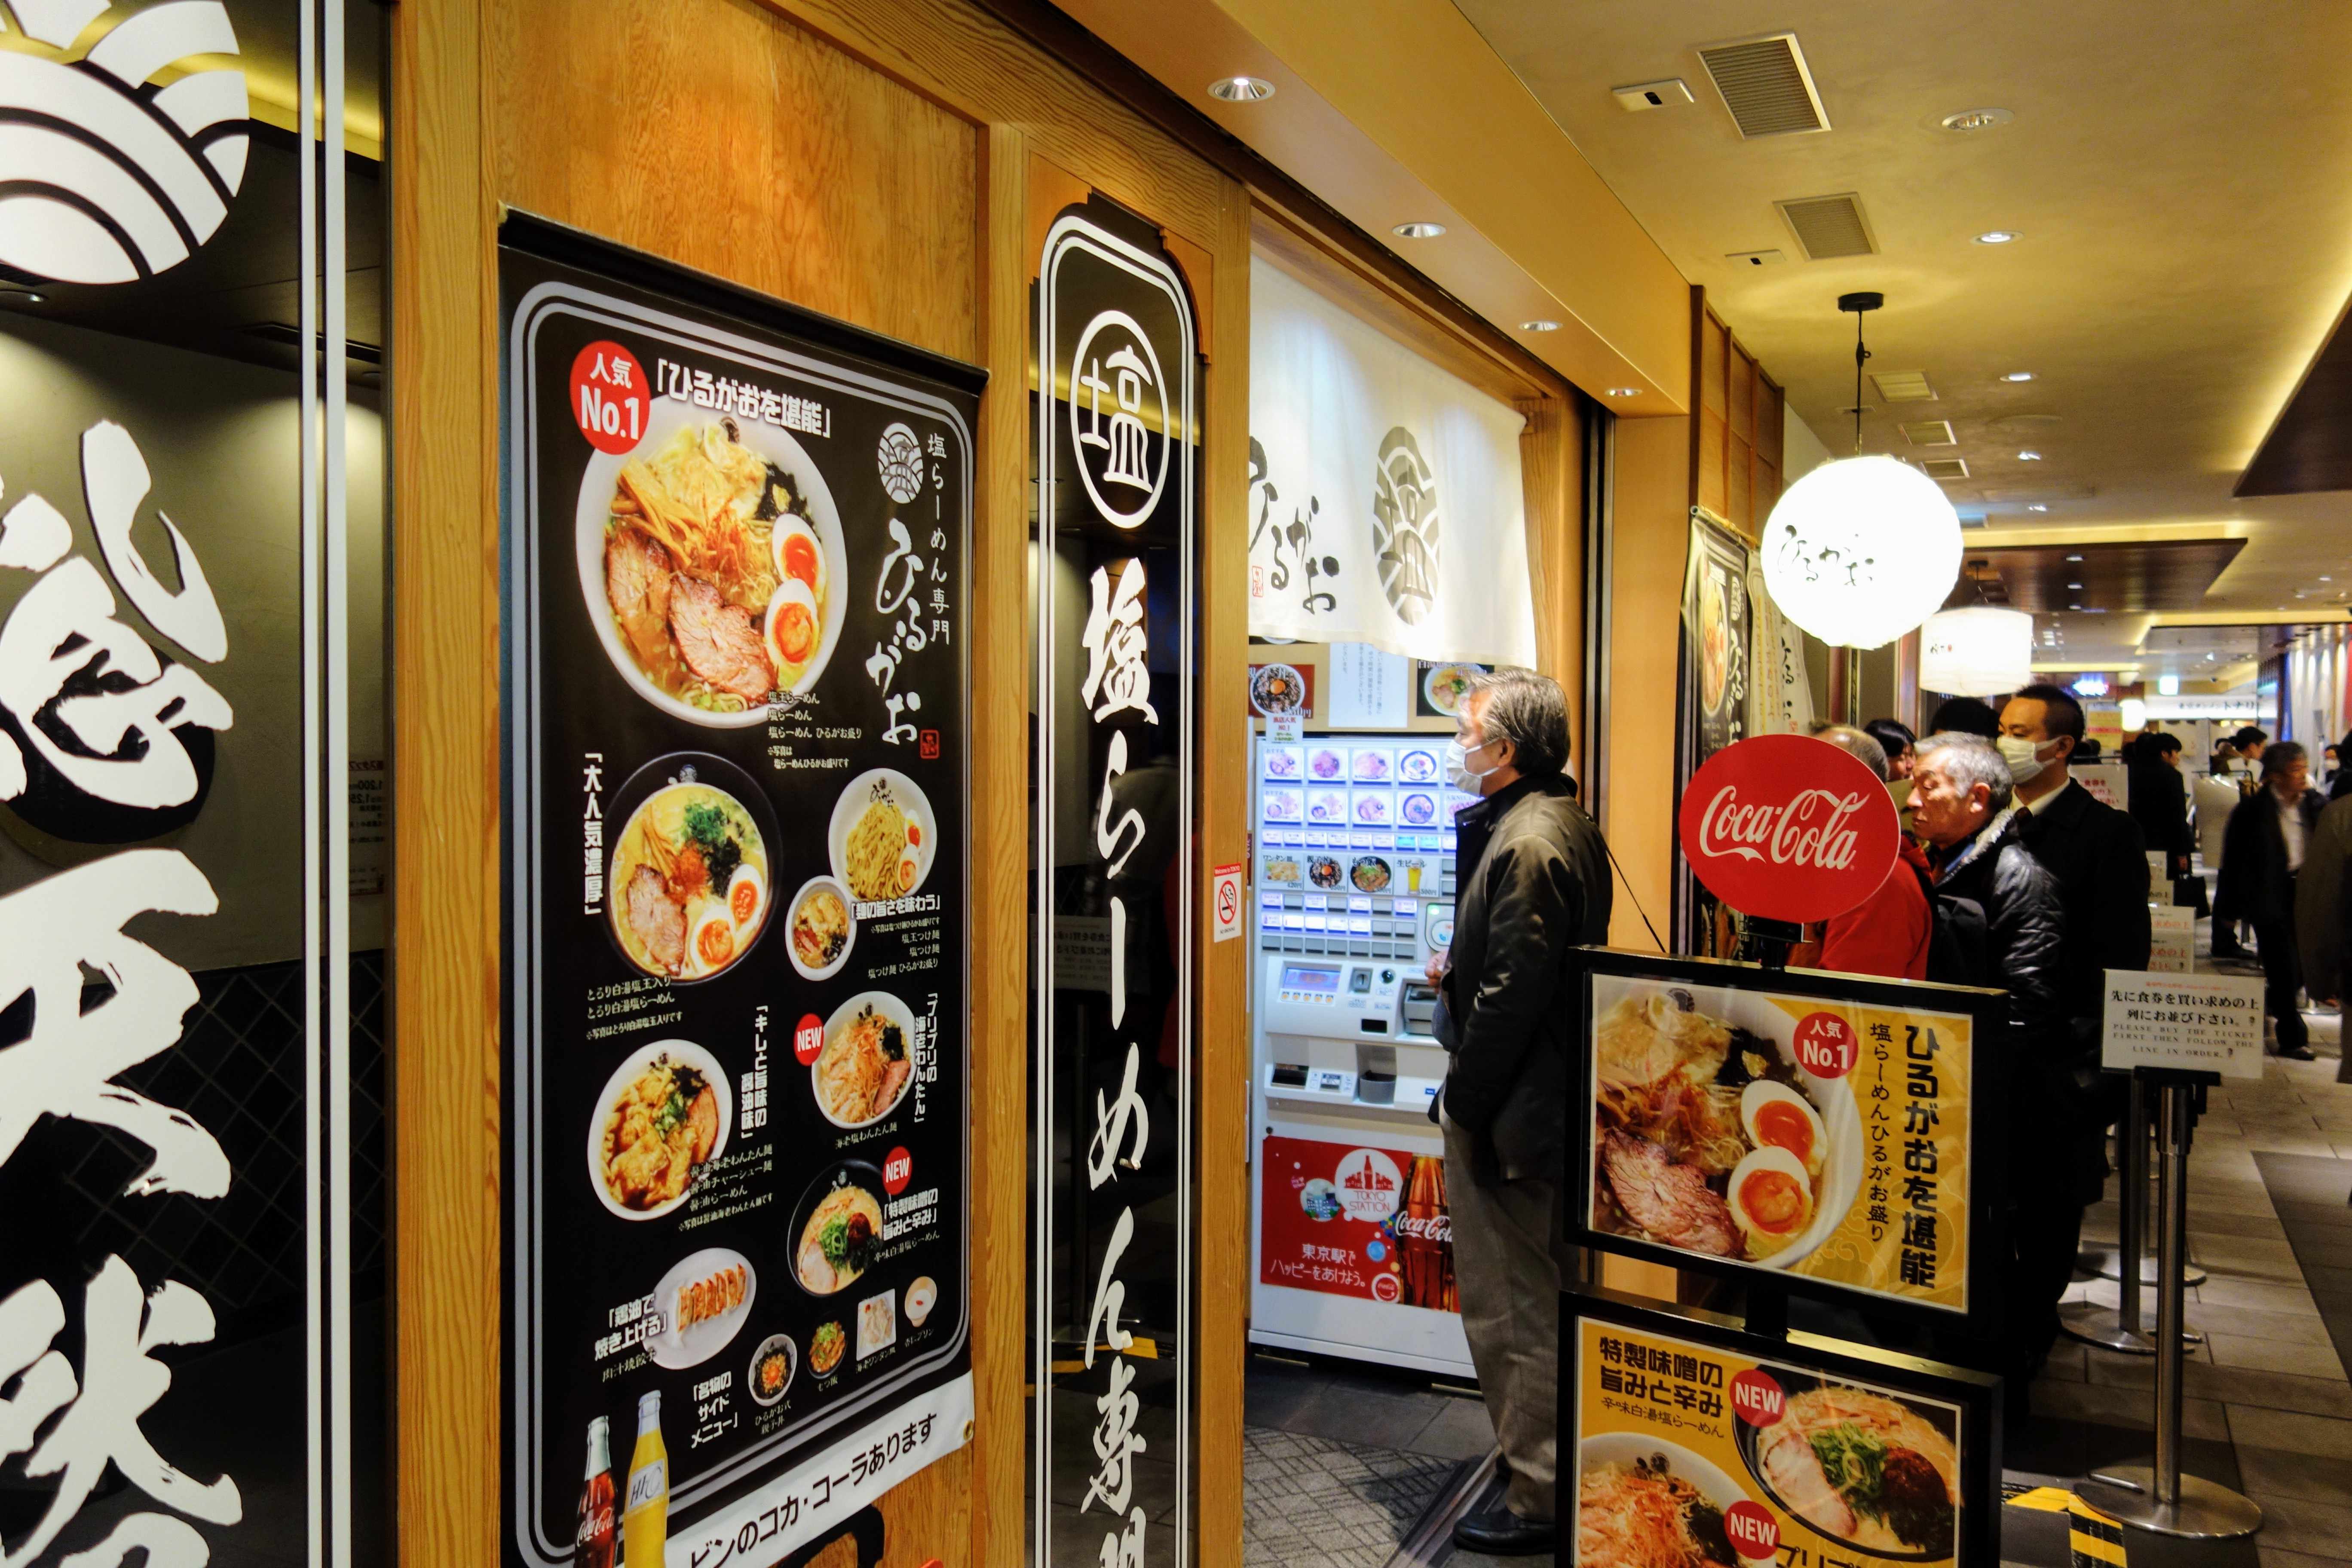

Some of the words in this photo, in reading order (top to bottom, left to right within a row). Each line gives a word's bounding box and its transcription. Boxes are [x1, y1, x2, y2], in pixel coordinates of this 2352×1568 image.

[590, 354, 632, 388] 人気
[581, 386, 639, 441] No.1
[658, 359, 830, 438] 「ひるがおを堪能」
[1080, 344, 1152, 494] 塩
[928, 433, 949, 645] 塩らーめん専門
[866, 518, 926, 745] ひるがお
[768, 709, 812, 721] 塩らーめん
[768, 726, 812, 738] 塩らーめん
[817, 728, 861, 739] ひるがお盛り
[1700, 786, 1870, 870] Coca-Cola
[910, 943, 940, 957] 塩つけ麺
[2112, 990, 2259, 1010] 先に食券を買い求めの上
[797, 1026, 822, 1052] NEW
[1810, 1020, 1842, 1038] 人気
[2187, 1037, 2226, 1045] FOLLOW
[2215, 1030, 2255, 1038] TICKET
[1803, 1039, 1847, 1069] No.1
[1867, 1023, 1892, 1241] 塩らーめんひるがお盛り
[886, 1157, 910, 1183] NEW
[1900, 1025, 1940, 1289] ひるがおを堪能
[1350, 1201, 1390, 1212] STATION
[1354, 1191, 1386, 1202] TOKYO
[1302, 1243, 1356, 1266] 東京駅で
[1599, 1336, 1722, 1389] 特製味噌の
[1601, 1365, 1724, 1418] 旨みと辛み
[1735, 1382, 1782, 1414] NEW
[698, 1393, 729, 1423] サイド
[1601, 1396, 1724, 1438] 辛味白湯塩らーめん
[1730, 1512, 1776, 1547] NEW
